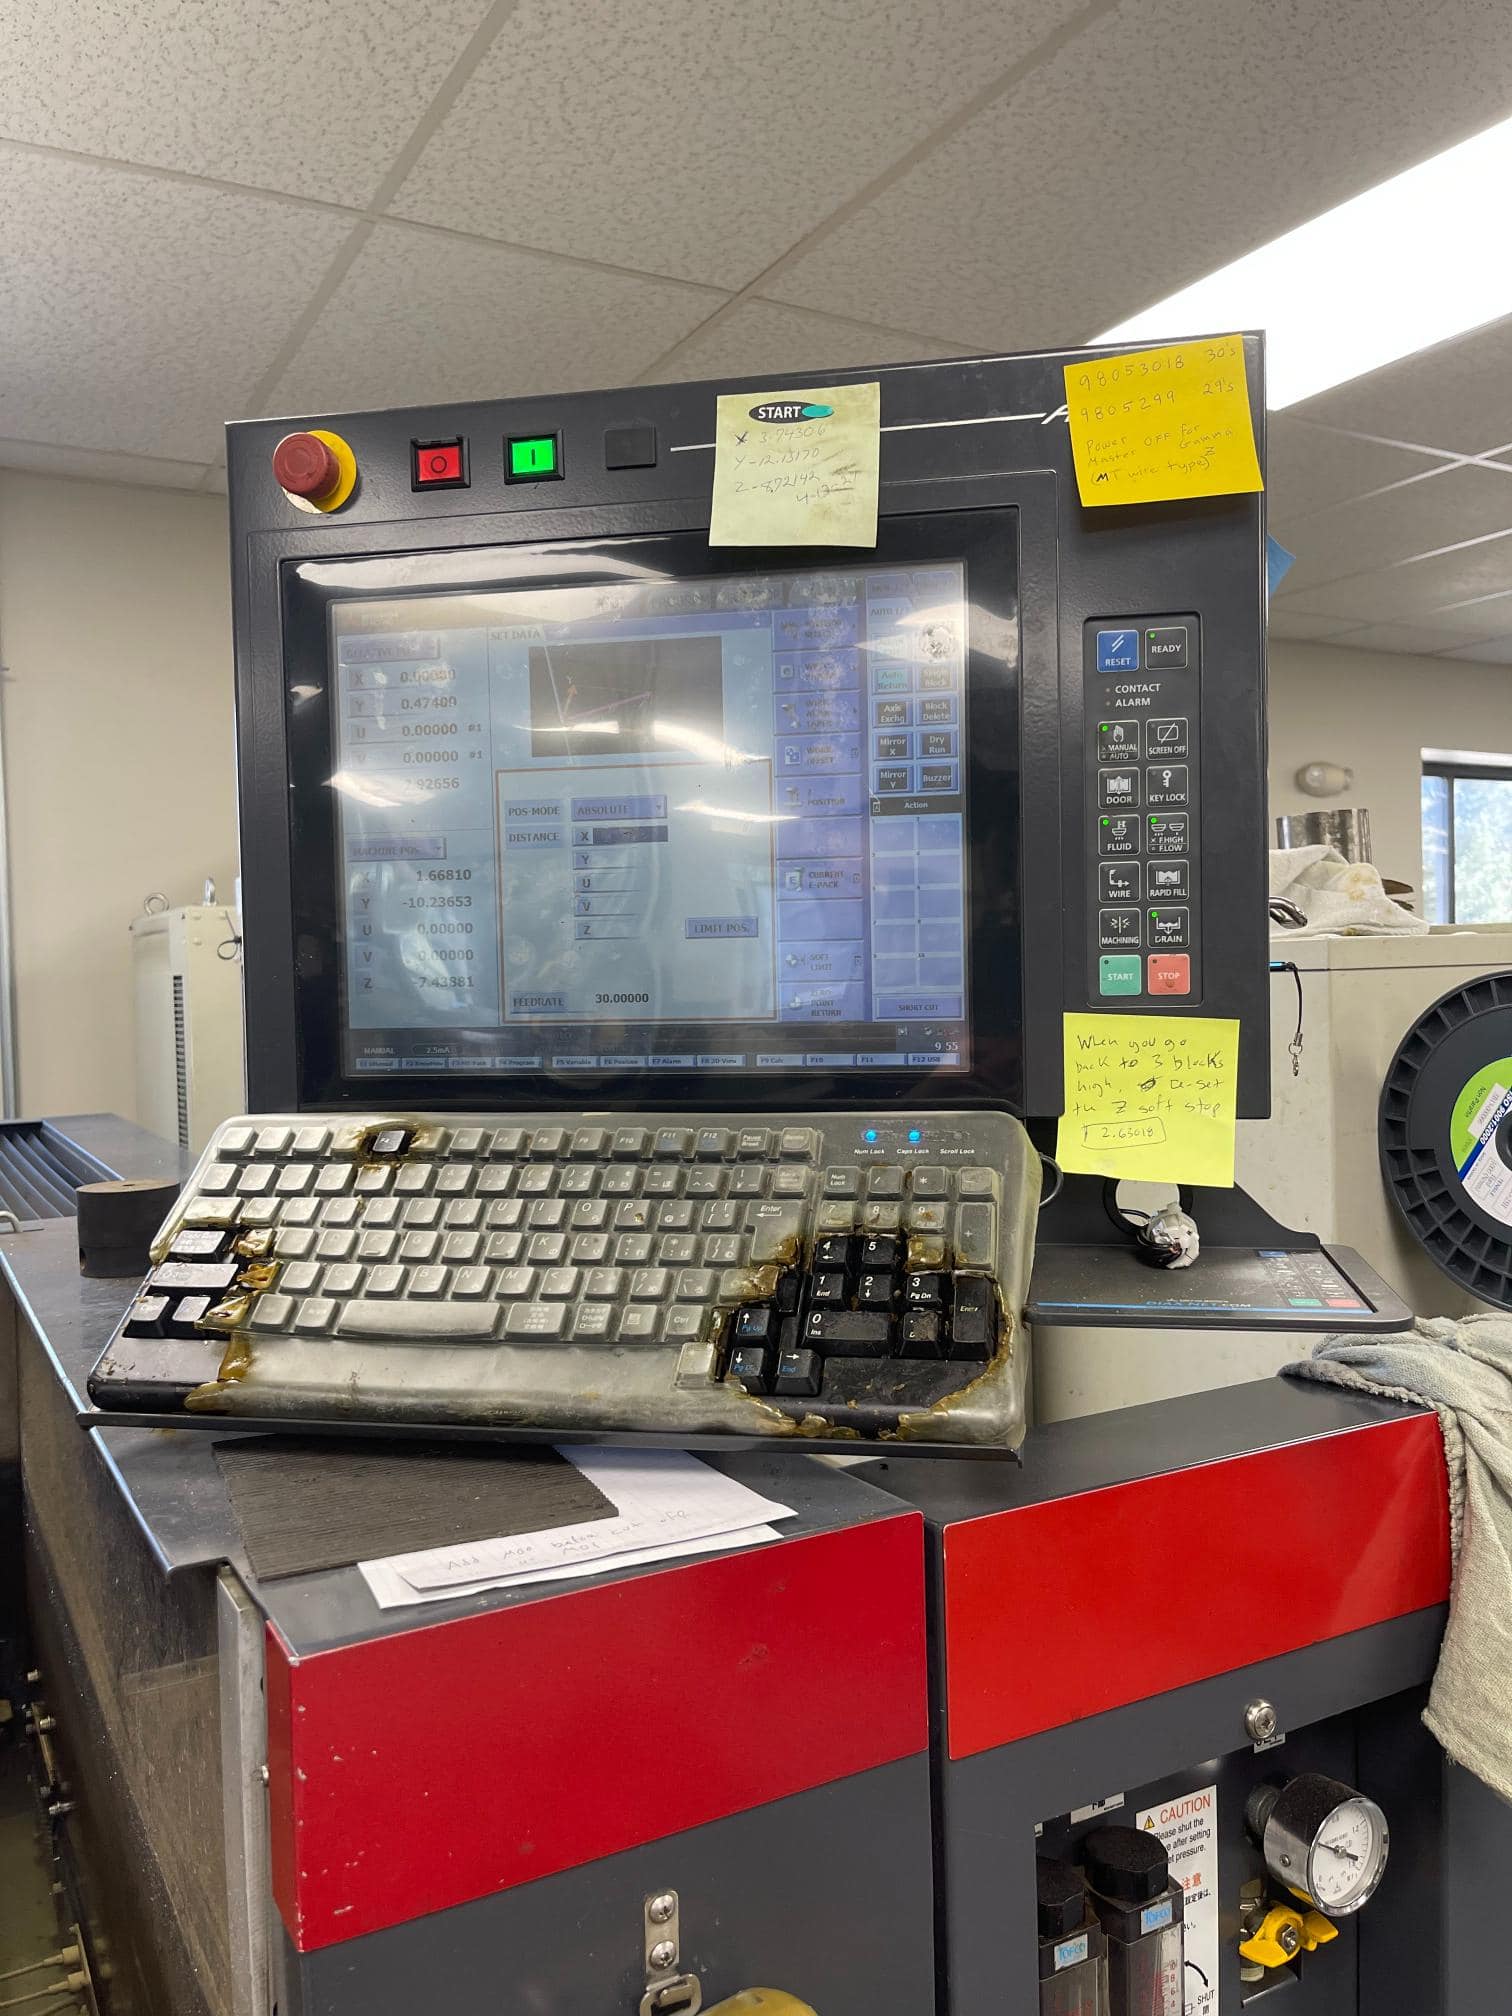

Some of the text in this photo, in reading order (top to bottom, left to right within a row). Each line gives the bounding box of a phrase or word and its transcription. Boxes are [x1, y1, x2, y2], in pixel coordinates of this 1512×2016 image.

[758, 406, 801, 419] START
[511, 628, 541, 640] DATA
[1151, 644, 1181, 653] READY
[1105, 658, 1131, 666] RESET
[1115, 684, 1161, 694] CONTACT
[925, 702, 948, 711] Block
[1115, 698, 1151, 707] ALARM
[883, 704, 901, 713] Axis
[923, 712, 950, 721] Delete
[402, 723, 458, 738] 0.00000
[880, 738, 906, 746] Mirror
[929, 736, 945, 746] Dry
[889, 748, 897, 756] X
[929, 746, 946, 754] Run
[1149, 745, 1186, 754] SCREEN OFF
[403, 751, 459, 764] 0.00000
[880, 771, 906, 780] Mirror
[923, 774, 952, 783] Buzzer
[904, 801, 929, 809] Action
[1106, 796, 1133, 804] DOOR
[577, 804, 629, 815] ABSOLUTE
[508, 832, 561, 842] DISTANCE
[580, 831, 589, 841] X
[1107, 843, 1132, 851] FLUID
[581, 855, 590, 865] Y
[416, 869, 472, 882] 1.66810
[582, 878, 591, 888] U
[1109, 890, 1131, 898] WIRE
[402, 896, 472, 909] -10.23653
[582, 902, 591, 912] V
[417, 923, 473, 935] 0.00000
[583, 926, 591, 935] Z
[694, 924, 723, 935] LIMIT
[1101, 936, 1139, 945] MACHINING
[1158, 972, 1180, 980] STOP
[363, 978, 372, 989] Z
[513, 992, 649, 1007] FEEDRATE 30.00000
[1077, 1036, 1187, 1053] When you go
[1075, 1057, 1110, 1072] back
[1119, 1058, 1138, 1068] to
[1152, 1054, 1163, 1068] 3
[1138, 1094, 1173, 1114] soft
[1185, 1098, 1220, 1118] stop
[624, 1203, 633, 1212] P
[760, 1205, 782, 1213] Enter
[827, 1205, 836, 1214] 7
[873, 1206, 880, 1215] 8
[540, 1237, 549, 1246] K
[581, 1238, 589, 1246] L
[822, 1240, 832, 1250] 4
[868, 1241, 877, 1251] 5
[461, 1270, 472, 1278] N
[507, 1271, 519, 1280] M
[819, 1275, 827, 1286] 1
[864, 1276, 874, 1287] 2
[911, 1277, 921, 1287] 3
[811, 1313, 822, 1324] 0
[1160, 1794, 1211, 1825] CAUTION
[1178, 1822, 1192, 1833] shut
[1193, 1817, 1204, 1828] the
[1173, 1837, 1188, 1850] after
[1188, 1828, 1211, 1844] setting
[1175, 1844, 1206, 1863] pressure.
[1197, 1990, 1215, 2006] SHUT
